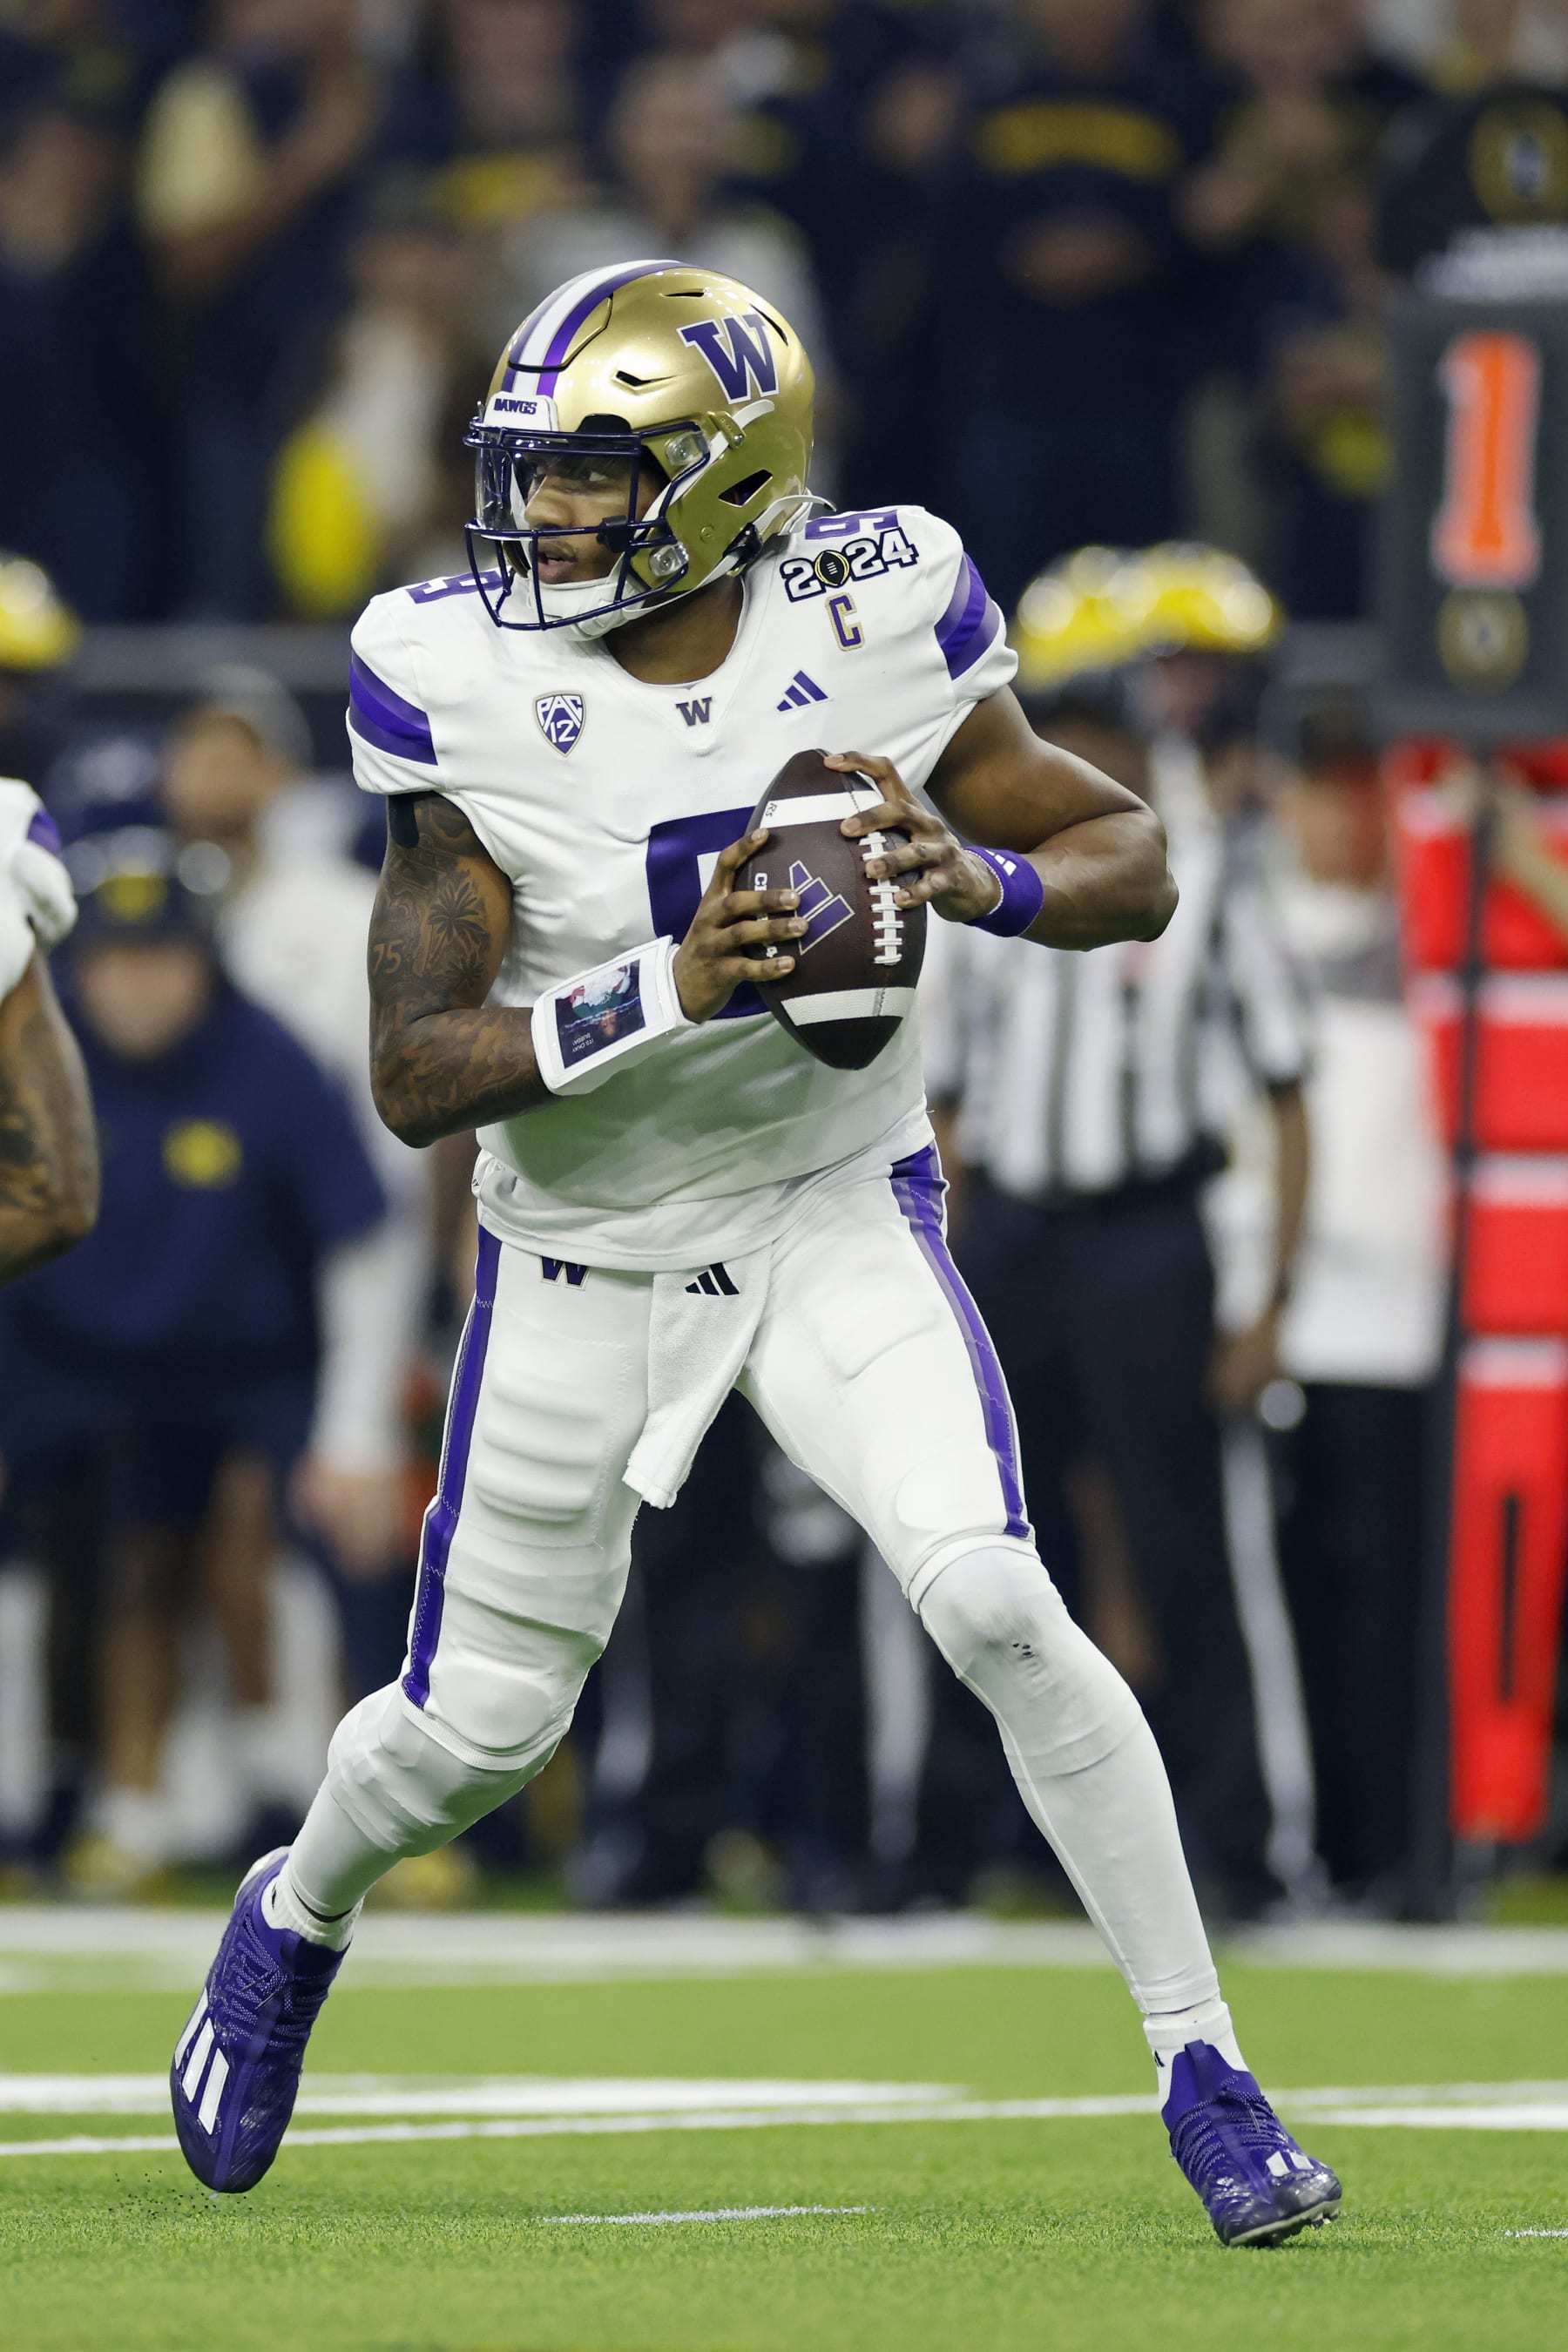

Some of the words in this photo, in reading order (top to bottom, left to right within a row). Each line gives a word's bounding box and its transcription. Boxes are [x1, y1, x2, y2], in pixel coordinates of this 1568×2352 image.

[677, 314, 780, 404] W
[493, 397, 538, 416] DAWGS
[1433, 331, 1542, 589] 1
[824, 592, 865, 652] C
[536, 694, 584, 733] PAC
[675, 696, 713, 727] W
[550, 720, 577, 744] 12
